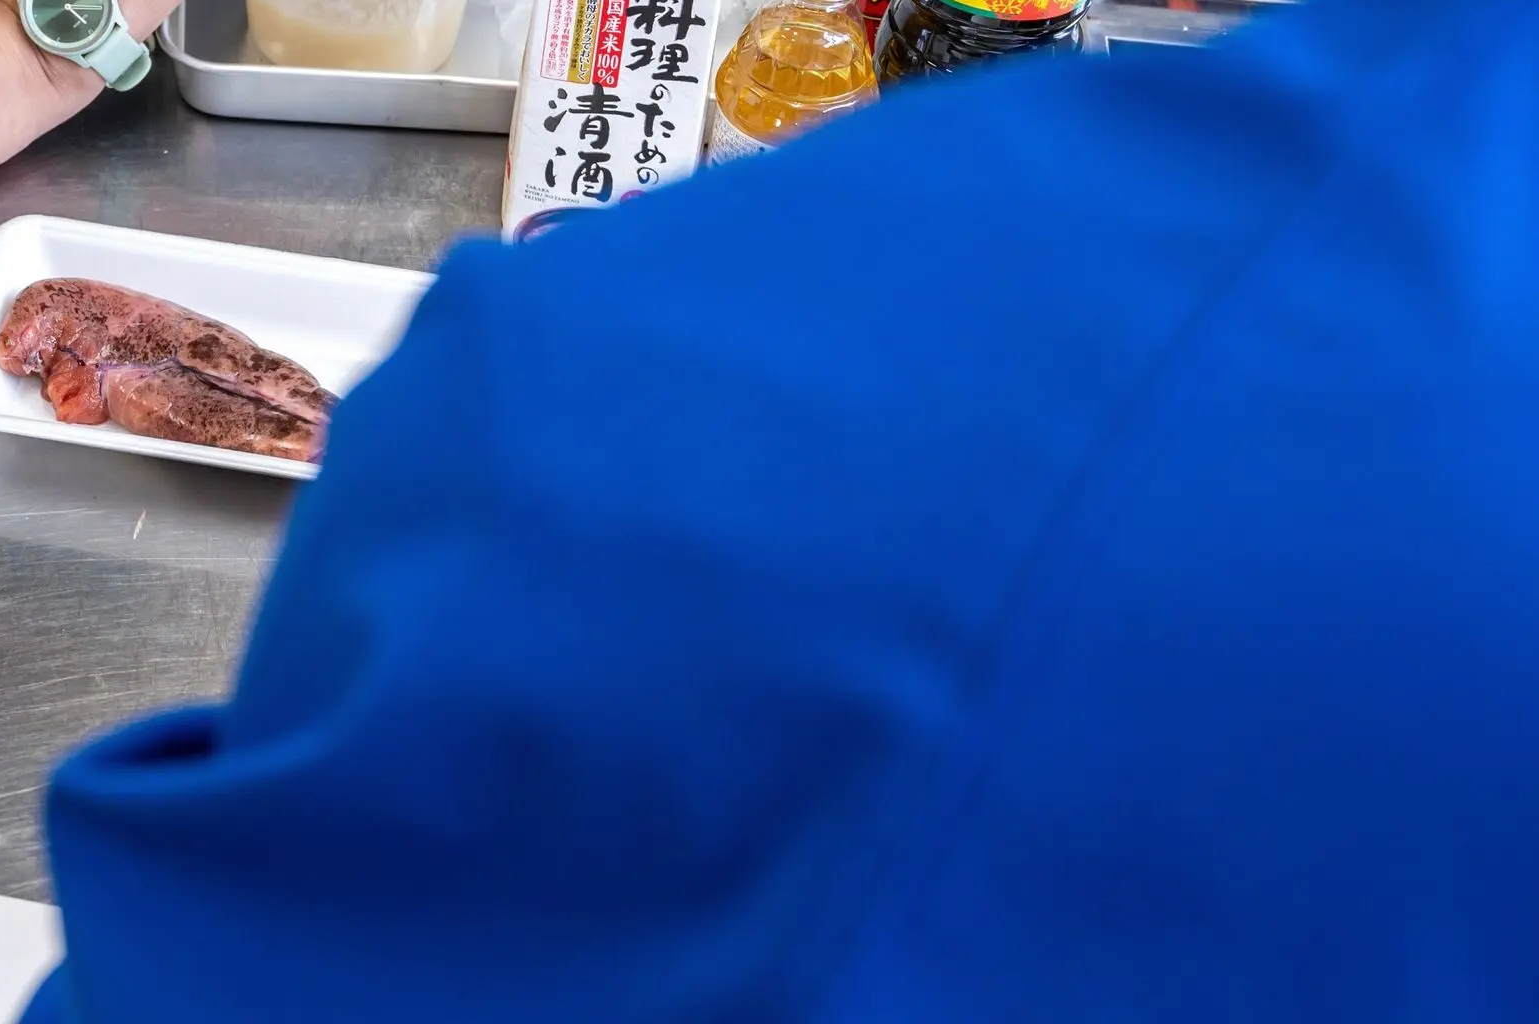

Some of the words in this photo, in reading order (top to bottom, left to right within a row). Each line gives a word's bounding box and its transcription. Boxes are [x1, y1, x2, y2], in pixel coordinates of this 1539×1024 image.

[596, 0, 625, 85] 国産米100%
[543, 82, 635, 202] 清酒
